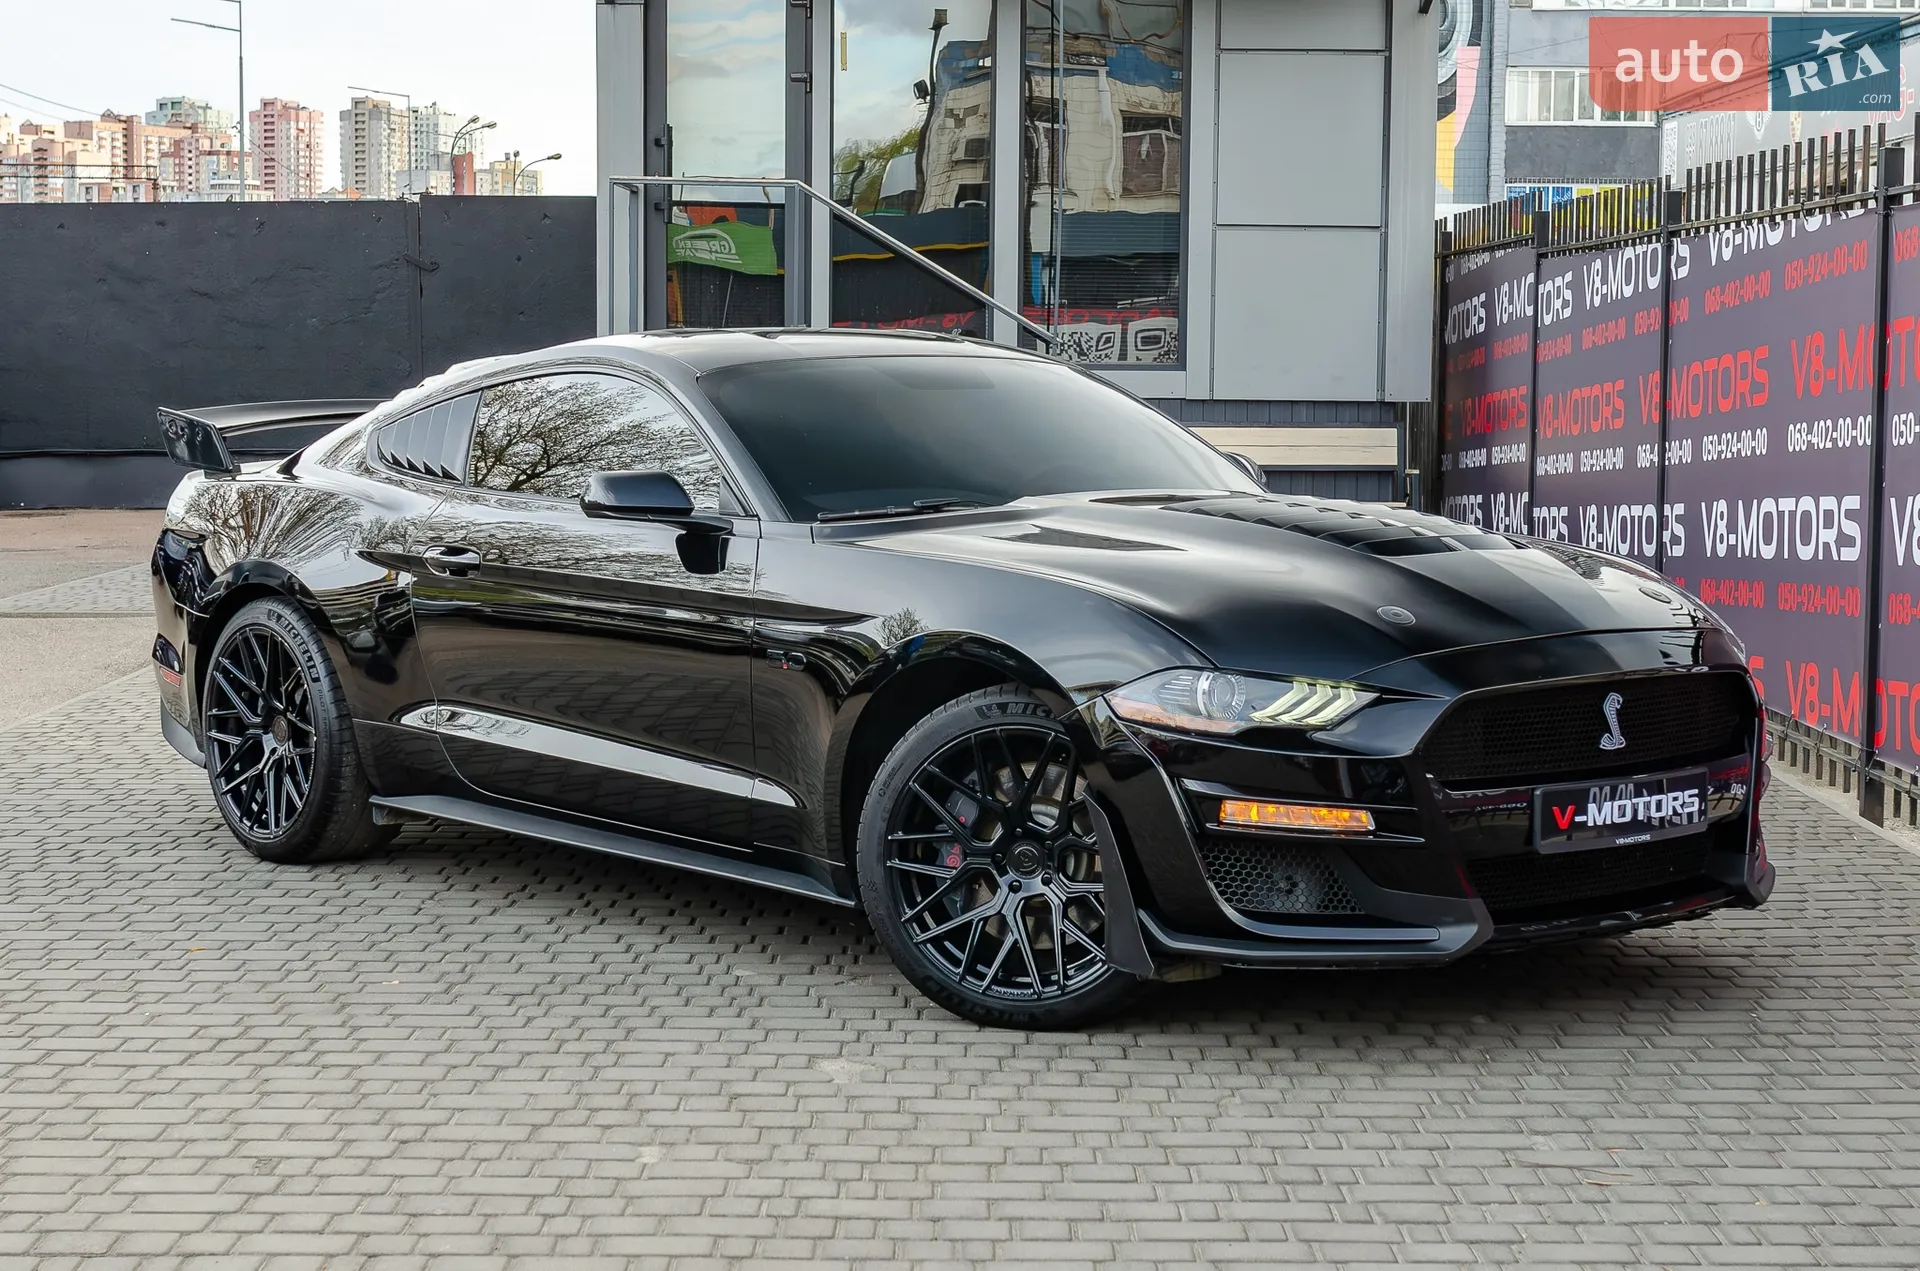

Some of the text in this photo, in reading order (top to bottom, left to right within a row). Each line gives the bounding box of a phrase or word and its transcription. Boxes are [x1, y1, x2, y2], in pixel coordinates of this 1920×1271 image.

[1705, 269, 1771, 315] 068-402-00-00
[1784, 239, 1868, 291] 050-924-00-00
[1537, 379, 1625, 440] V8-MOTORS
[1580, 447, 1624, 472] 050-924-00-00
[1637, 438, 1692, 468] 068-42-00-00
[1702, 427, 1768, 462] 050-924-00-00
[1787, 414, 1873, 453] 068-402-00-00
[1701, 495, 1861, 562] V8-MOTORS
[1700, 578, 1765, 608] 068-402-00-00
[1777, 582, 1861, 618] 050-924-00-00
[279, 617, 320, 679] MICHELIN
[1552, 789, 1699, 830] V-MOTORS
